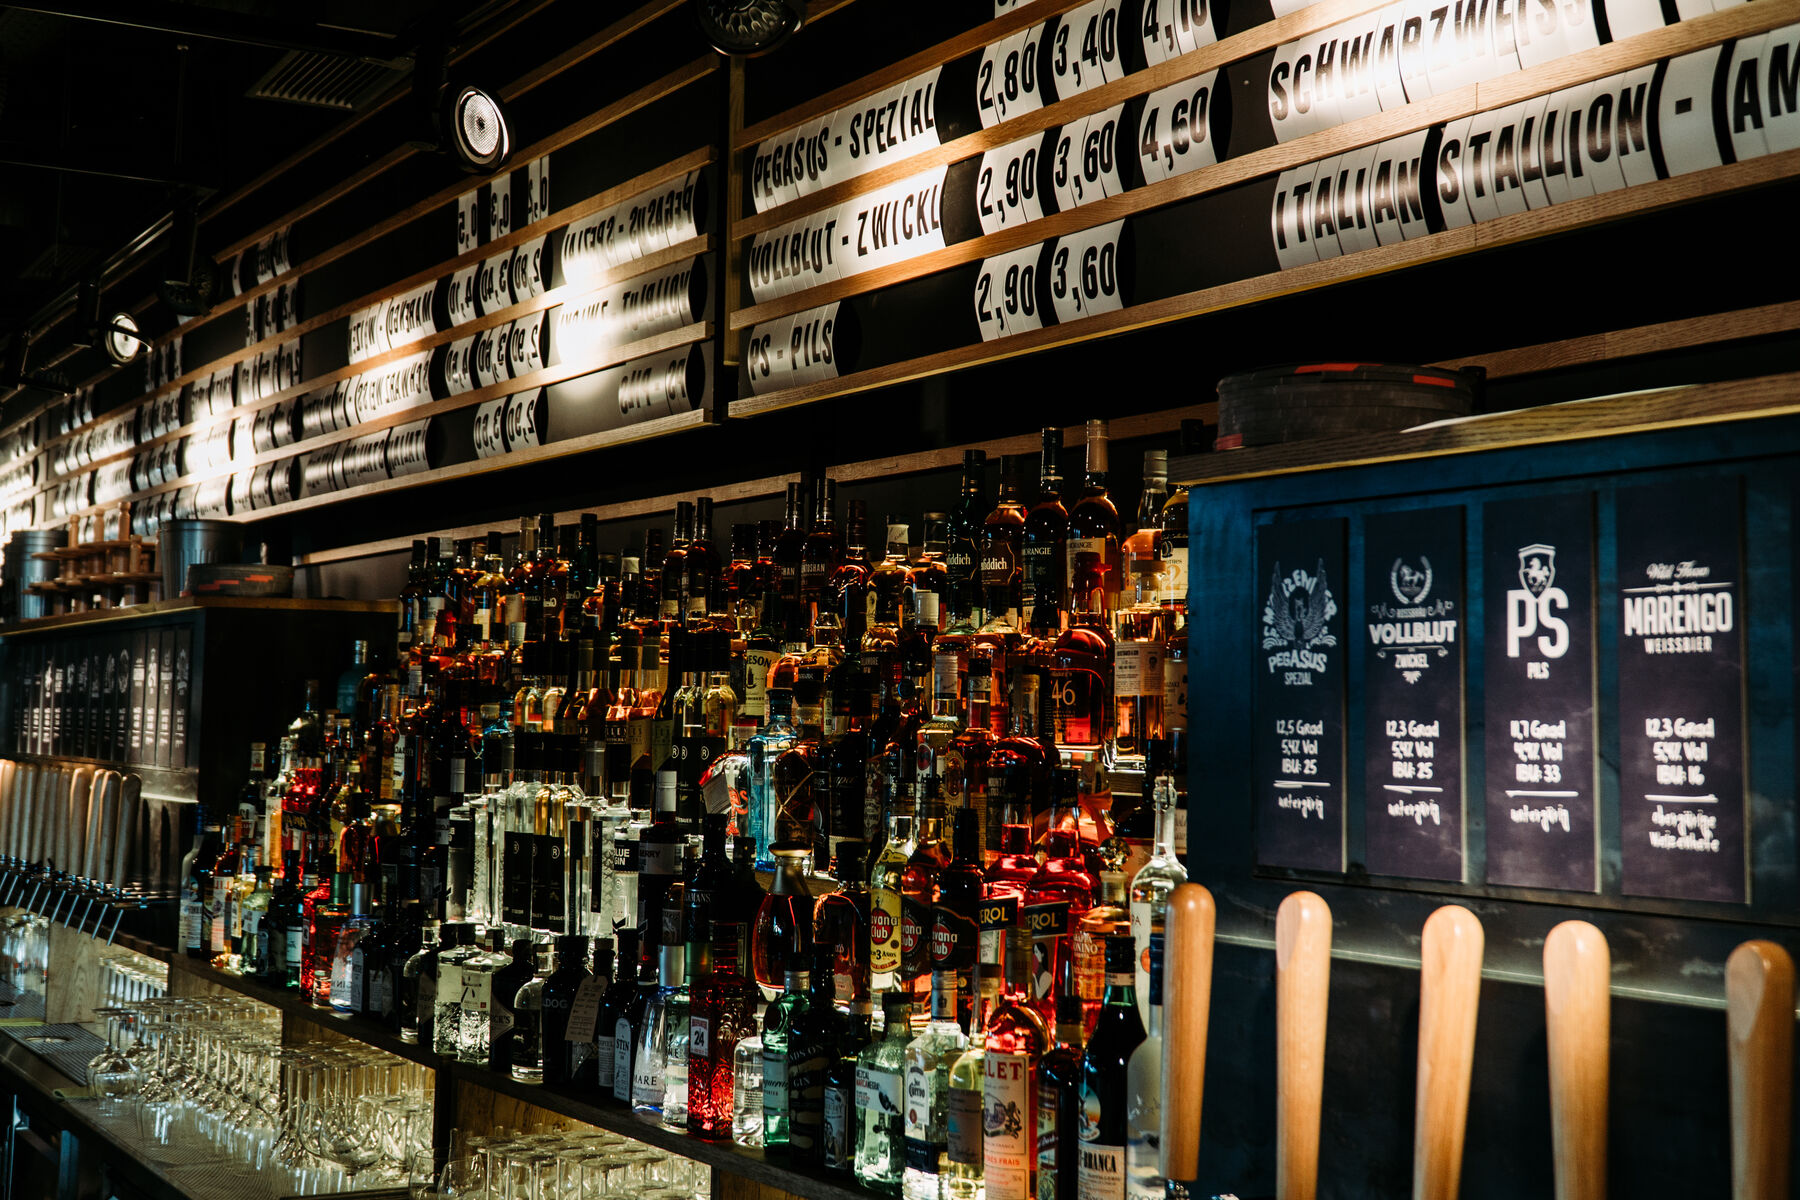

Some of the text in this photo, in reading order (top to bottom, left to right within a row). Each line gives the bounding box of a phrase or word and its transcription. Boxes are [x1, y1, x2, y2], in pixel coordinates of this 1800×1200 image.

[980, 0, 1208, 116] 2,80 3,40 4,10
[752, 127, 828, 199] PEGASUS
[849, 83, 935, 159] SPEZIAL
[979, 87, 1209, 222] 2,90 3,60 4,60
[1277, 157, 1423, 250] ITALIAN
[1439, 82, 1647, 204] STALLION
[751, 221, 835, 289] VOLLBLUT
[856, 194, 940, 257] ZWICKL
[977, 242, 1116, 330] 2,90 3,60
[748, 333, 770, 380] PS
[791, 319, 833, 371] PILS
[1507, 587, 1569, 658] PS
[1624, 592, 1733, 636] MARENGO
[1368, 620, 1457, 644] VOLLBLUT
[1644, 636, 1712, 654] WEISSBIER
[1268, 649, 1327, 673] PEGASUS
[1395, 653, 1429, 669] ZWICKEL
[1527, 662, 1549, 679] PILS
[1284, 672, 1312, 685] SPEZIAL
[1051, 680, 1076, 708] 46
[1276, 719, 1295, 736] 12,5
[1386, 720, 1440, 738] 12,3 Grad
[1530, 720, 1566, 740] Grad
[1645, 717, 1715, 739] 12,3 Grad
[1302, 739, 1318, 755] Vol
[1415, 741, 1434, 758] Vol
[1541, 742, 1563, 761] Vol
[1683, 742, 1708, 761] Vol
[1303, 759, 1317, 775] 25
[1417, 762, 1433, 779] 25
[1543, 764, 1561, 783] 33
[693, 1030, 706, 1046] 24
